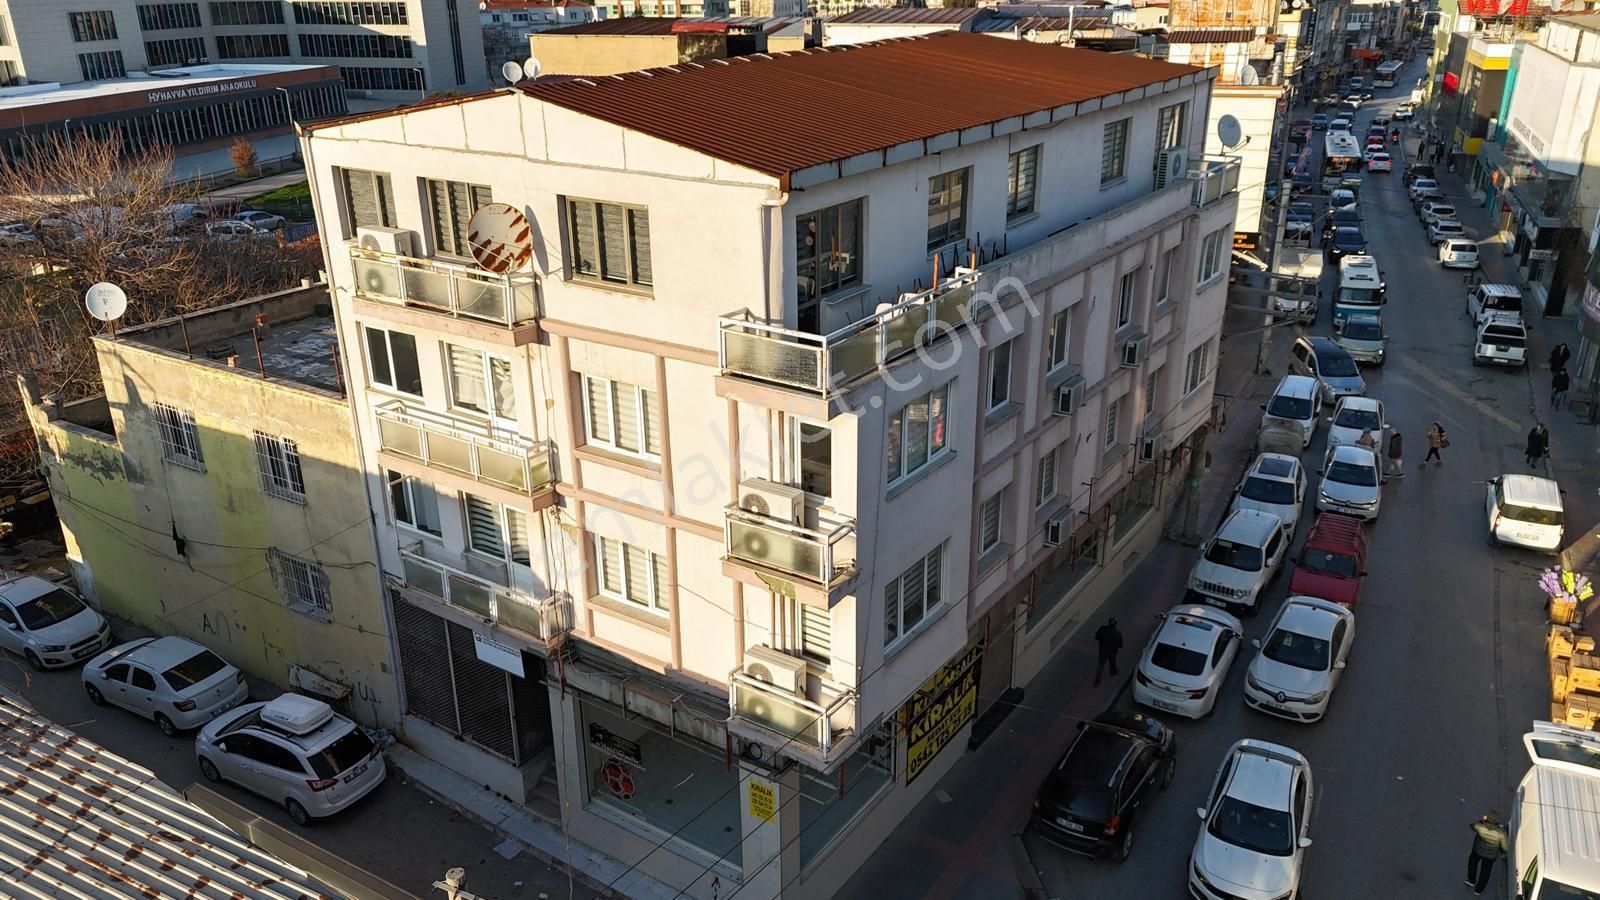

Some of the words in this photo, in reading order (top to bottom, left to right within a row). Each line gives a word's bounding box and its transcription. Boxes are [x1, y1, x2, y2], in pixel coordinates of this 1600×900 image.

[161, 90, 186, 101] HAVVA
[187, 84, 219, 96] YILDIRIM
[220, 80, 257, 92] ANAOKULU
